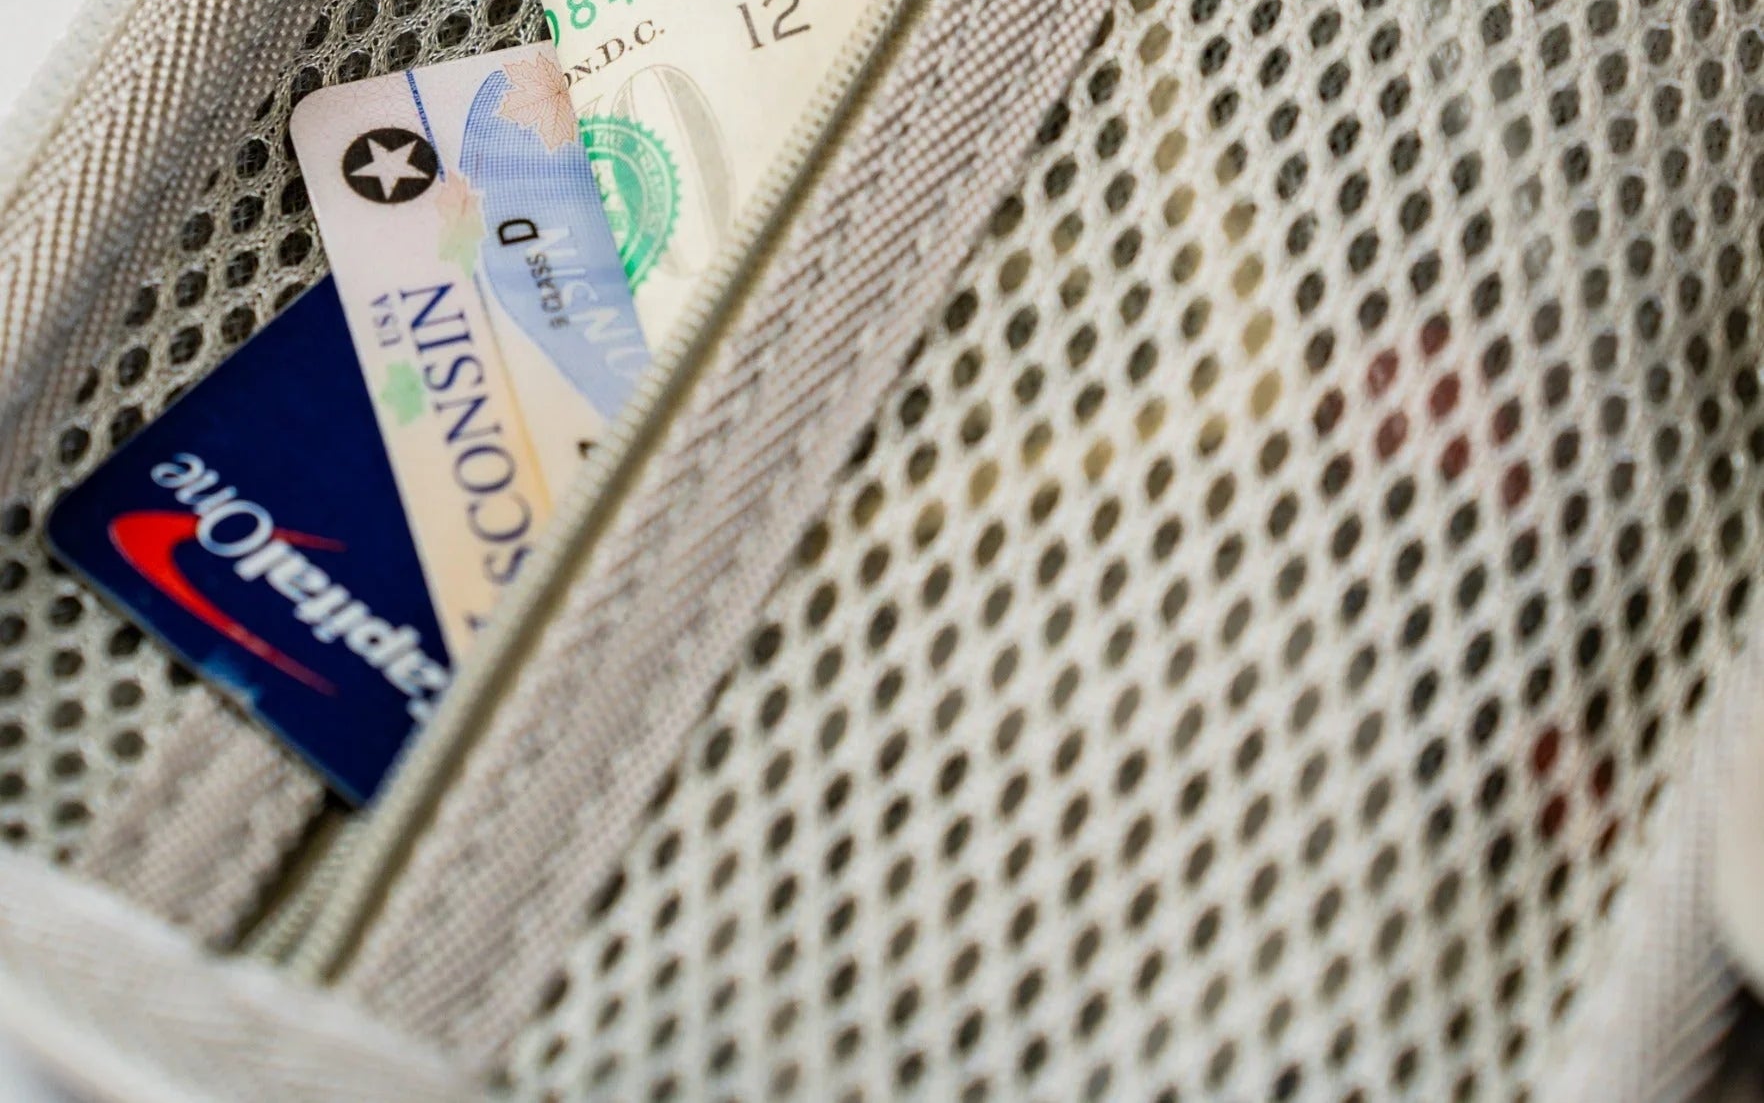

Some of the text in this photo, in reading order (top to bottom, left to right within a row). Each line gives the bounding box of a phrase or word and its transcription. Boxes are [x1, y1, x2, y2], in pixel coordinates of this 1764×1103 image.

[497, 218, 539, 246] D
[526, 253, 564, 314] CLASS
[371, 292, 403, 348] USA
[399, 282, 533, 631] SCONSIN
[150, 452, 450, 723] apitalOne
